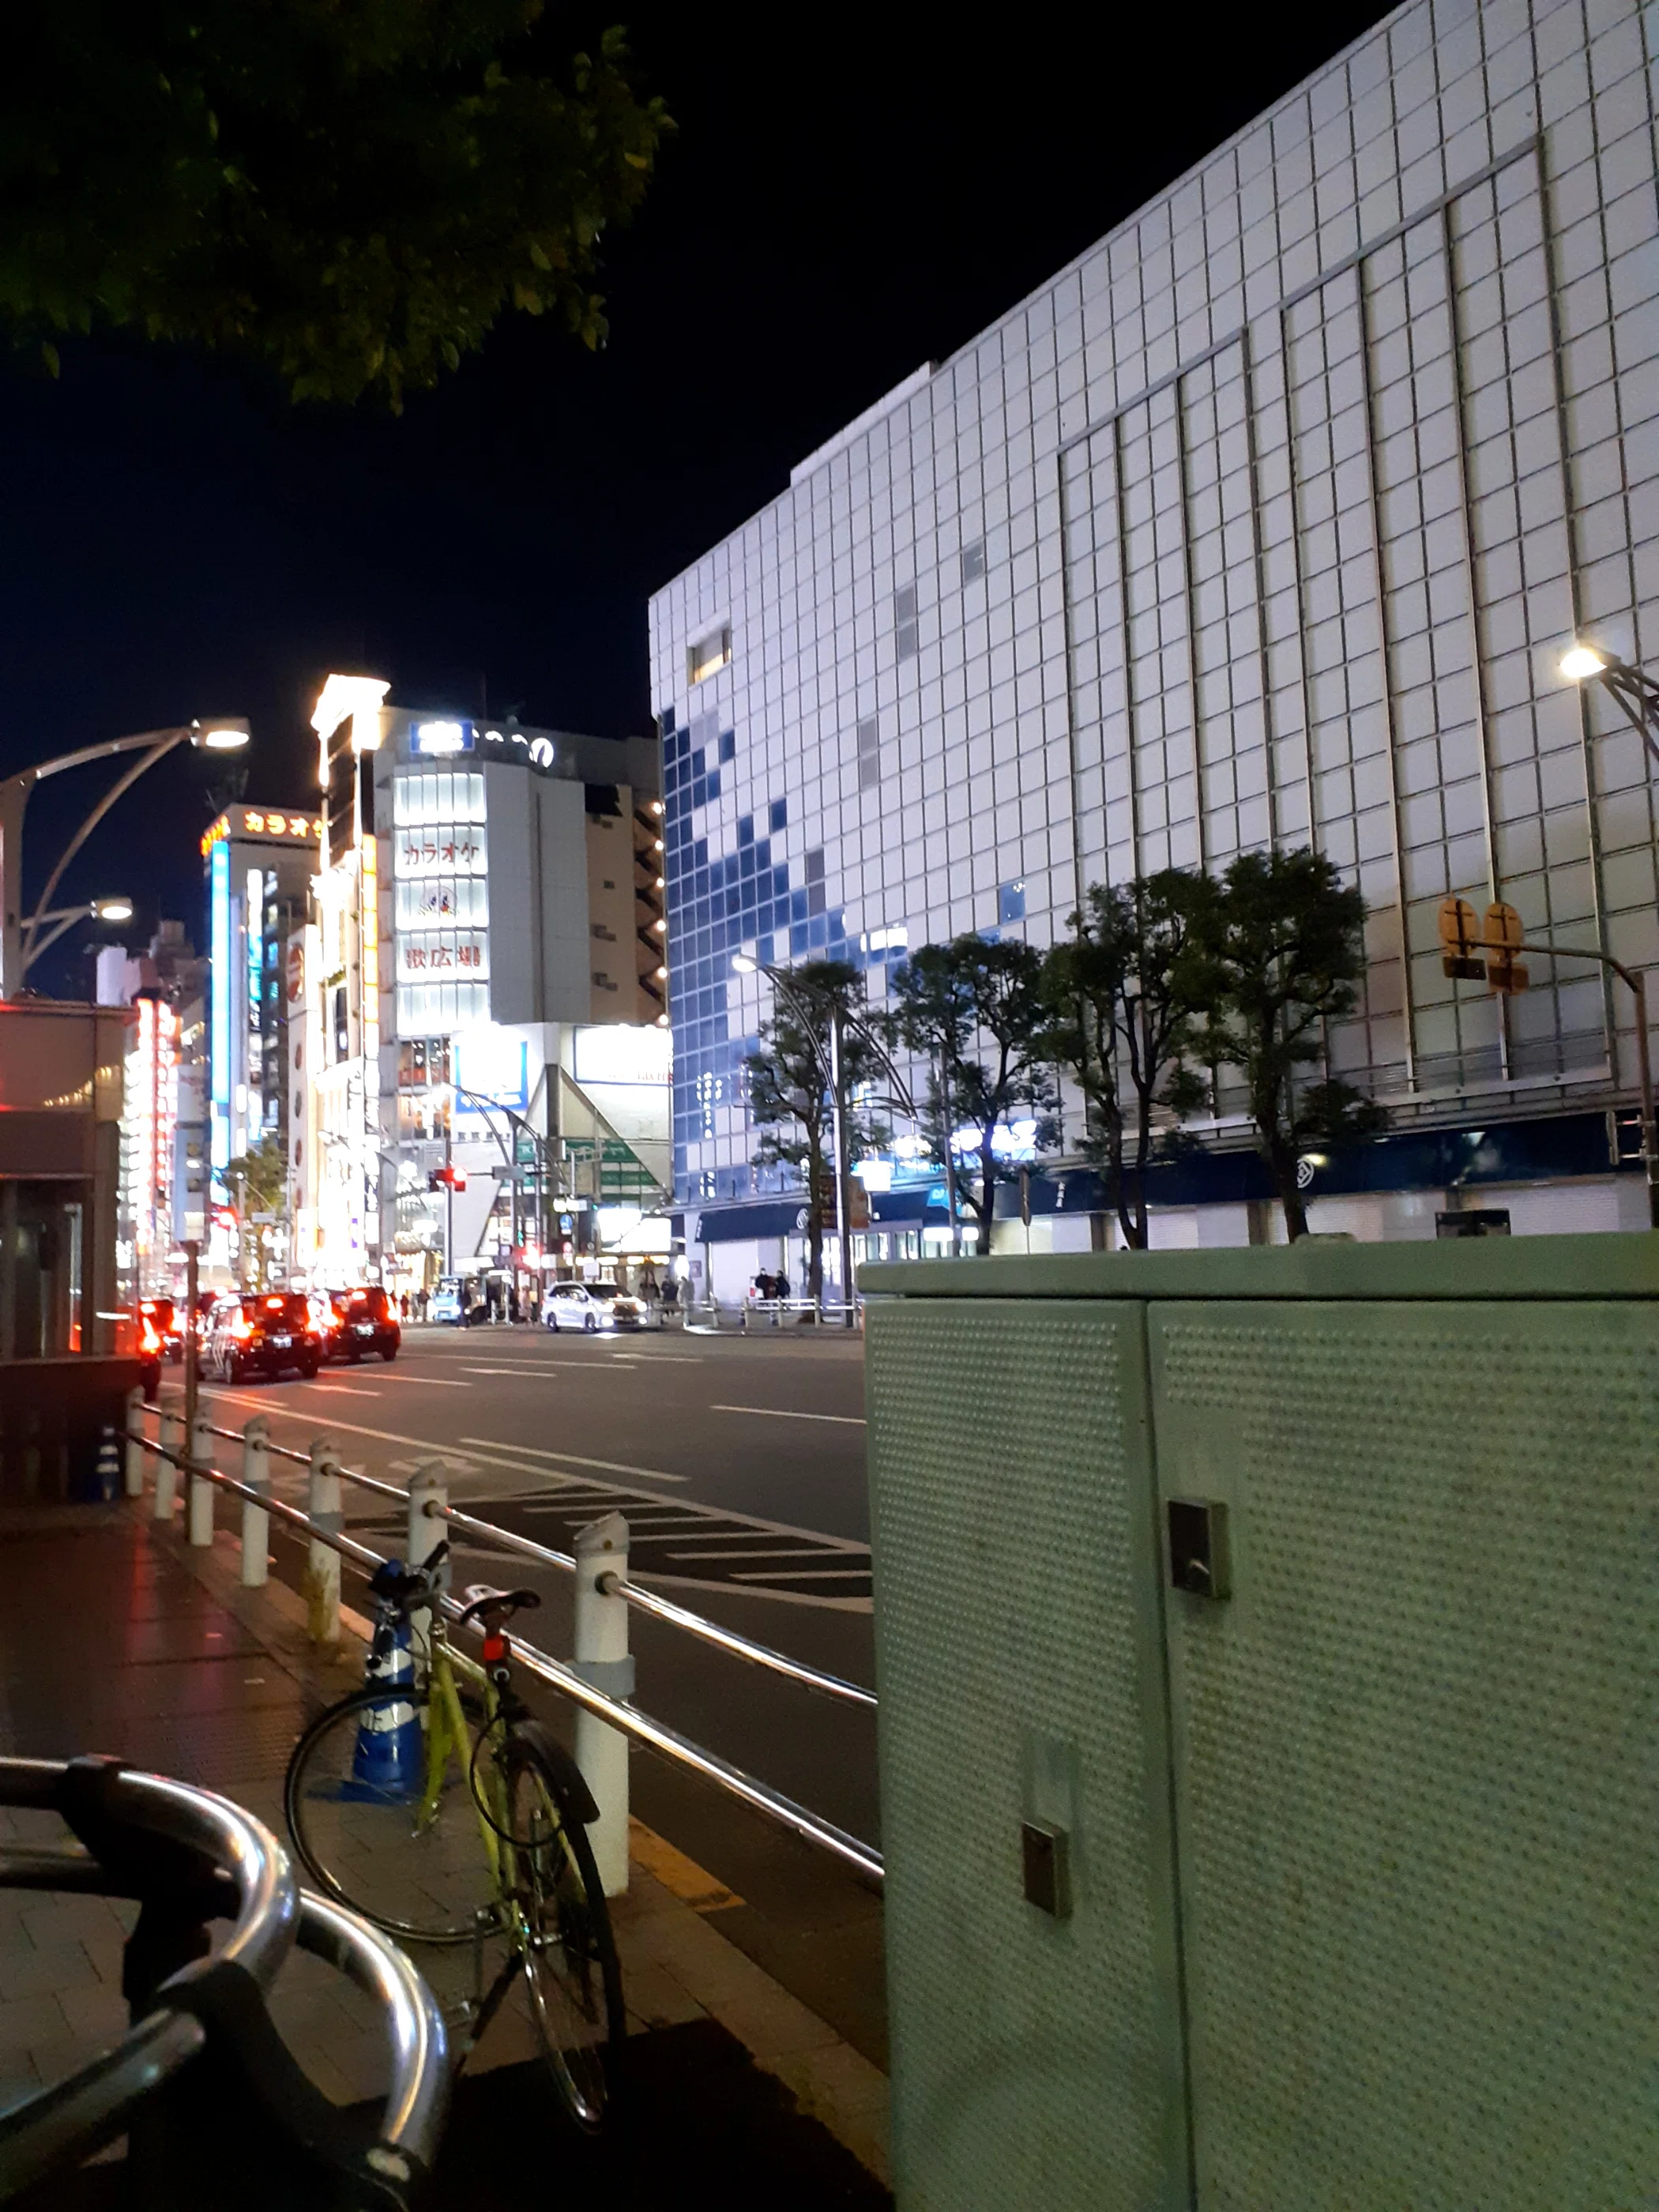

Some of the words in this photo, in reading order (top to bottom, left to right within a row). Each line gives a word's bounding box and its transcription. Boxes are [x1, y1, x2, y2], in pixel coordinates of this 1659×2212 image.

[404, 841, 480, 866] カラオケ
[406, 945, 480, 970] 歌広場
